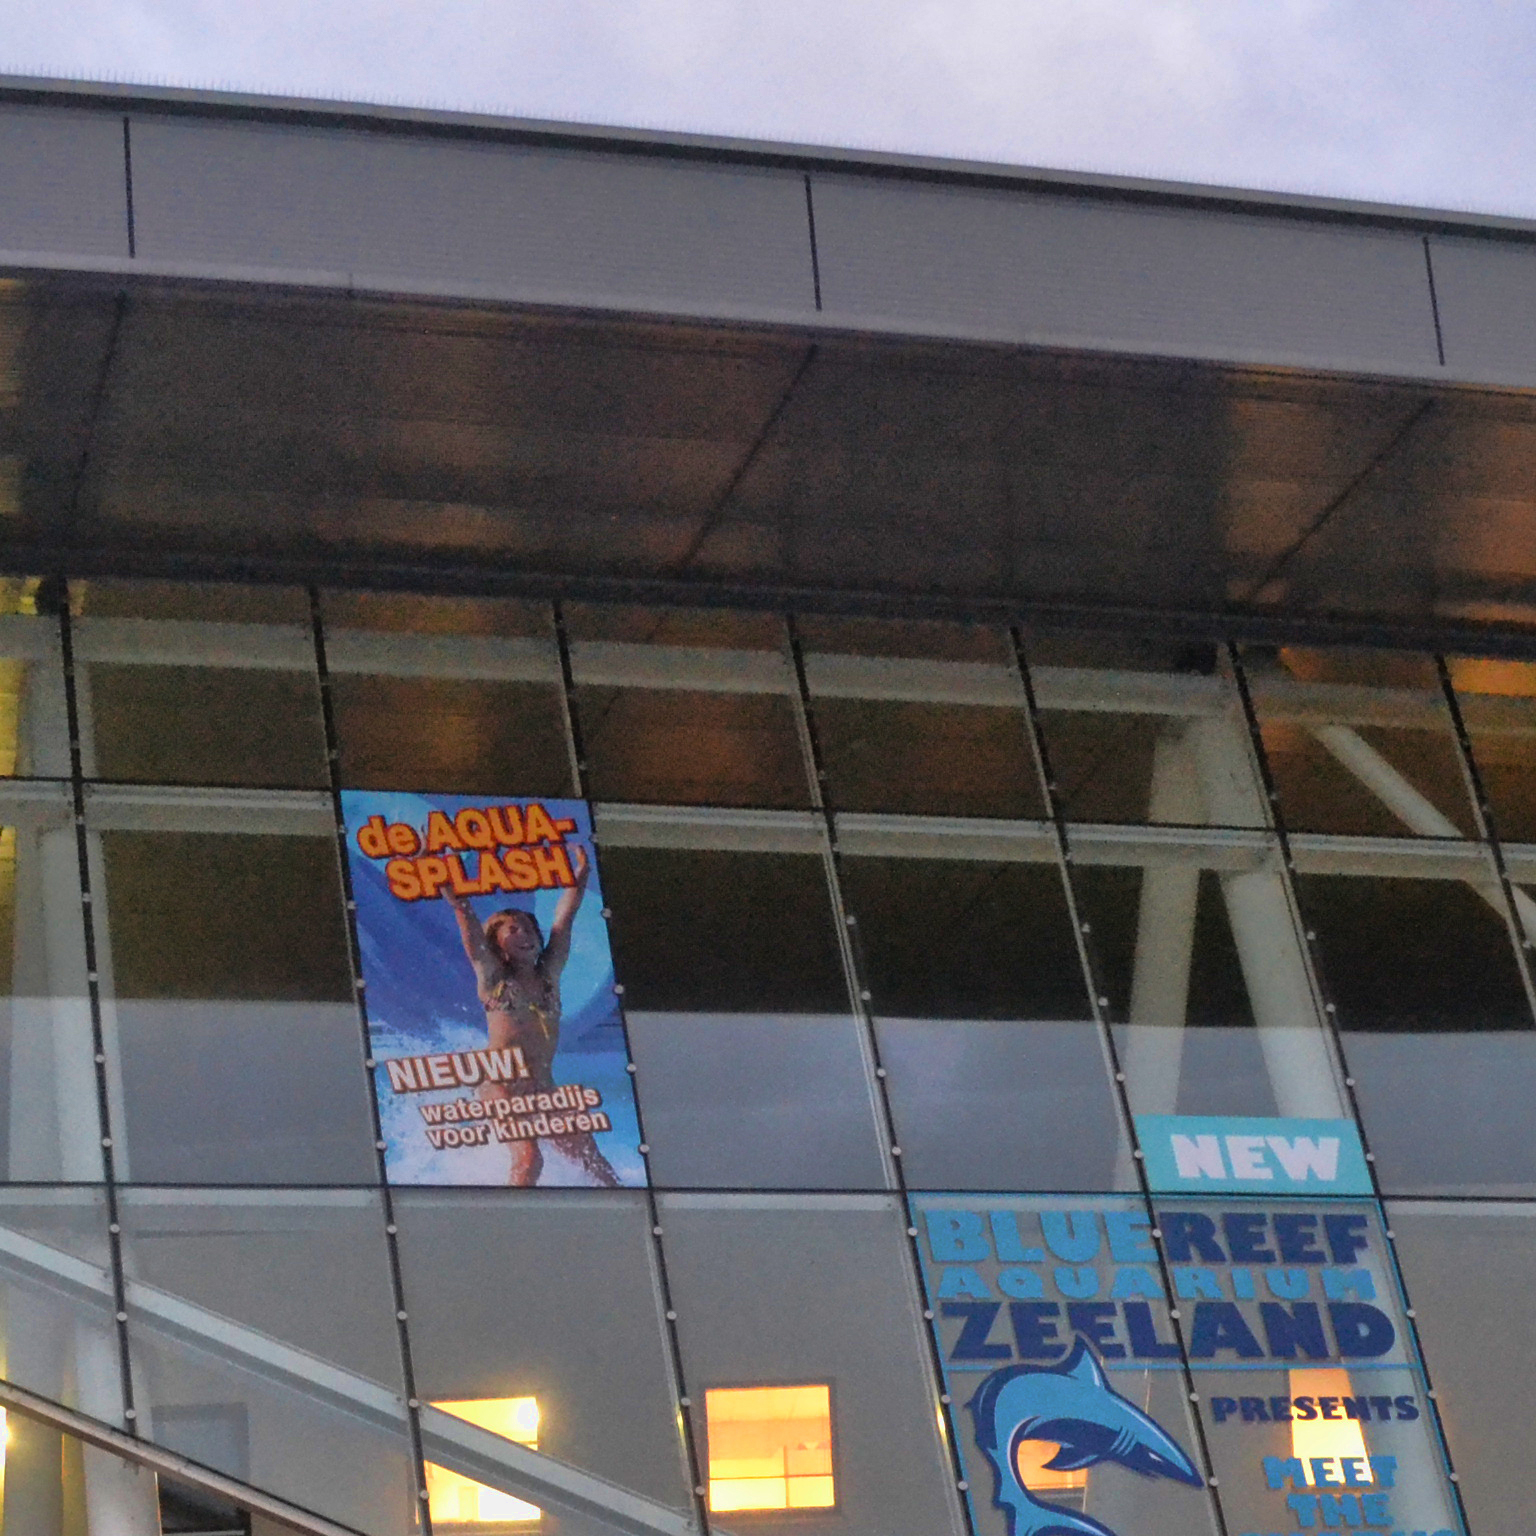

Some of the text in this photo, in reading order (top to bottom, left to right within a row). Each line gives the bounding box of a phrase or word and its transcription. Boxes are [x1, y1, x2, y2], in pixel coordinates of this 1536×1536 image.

[357, 803, 578, 859] de AQUA-
[386, 845, 575, 901] SPLASH
[387, 1047, 532, 1092] NIEUW!
[418, 1083, 602, 1126] waterparadijs
[426, 1110, 611, 1150] voor kinderen
[1170, 1134, 1342, 1181] NEW
[937, 1266, 1377, 1300] AQUARIUM
[941, 1301, 1396, 1360] ZEELAND
[1210, 1396, 1420, 1423] PRESENTS
[1262, 1455, 1399, 1489] MEET
[1287, 1494, 1395, 1527] THE
